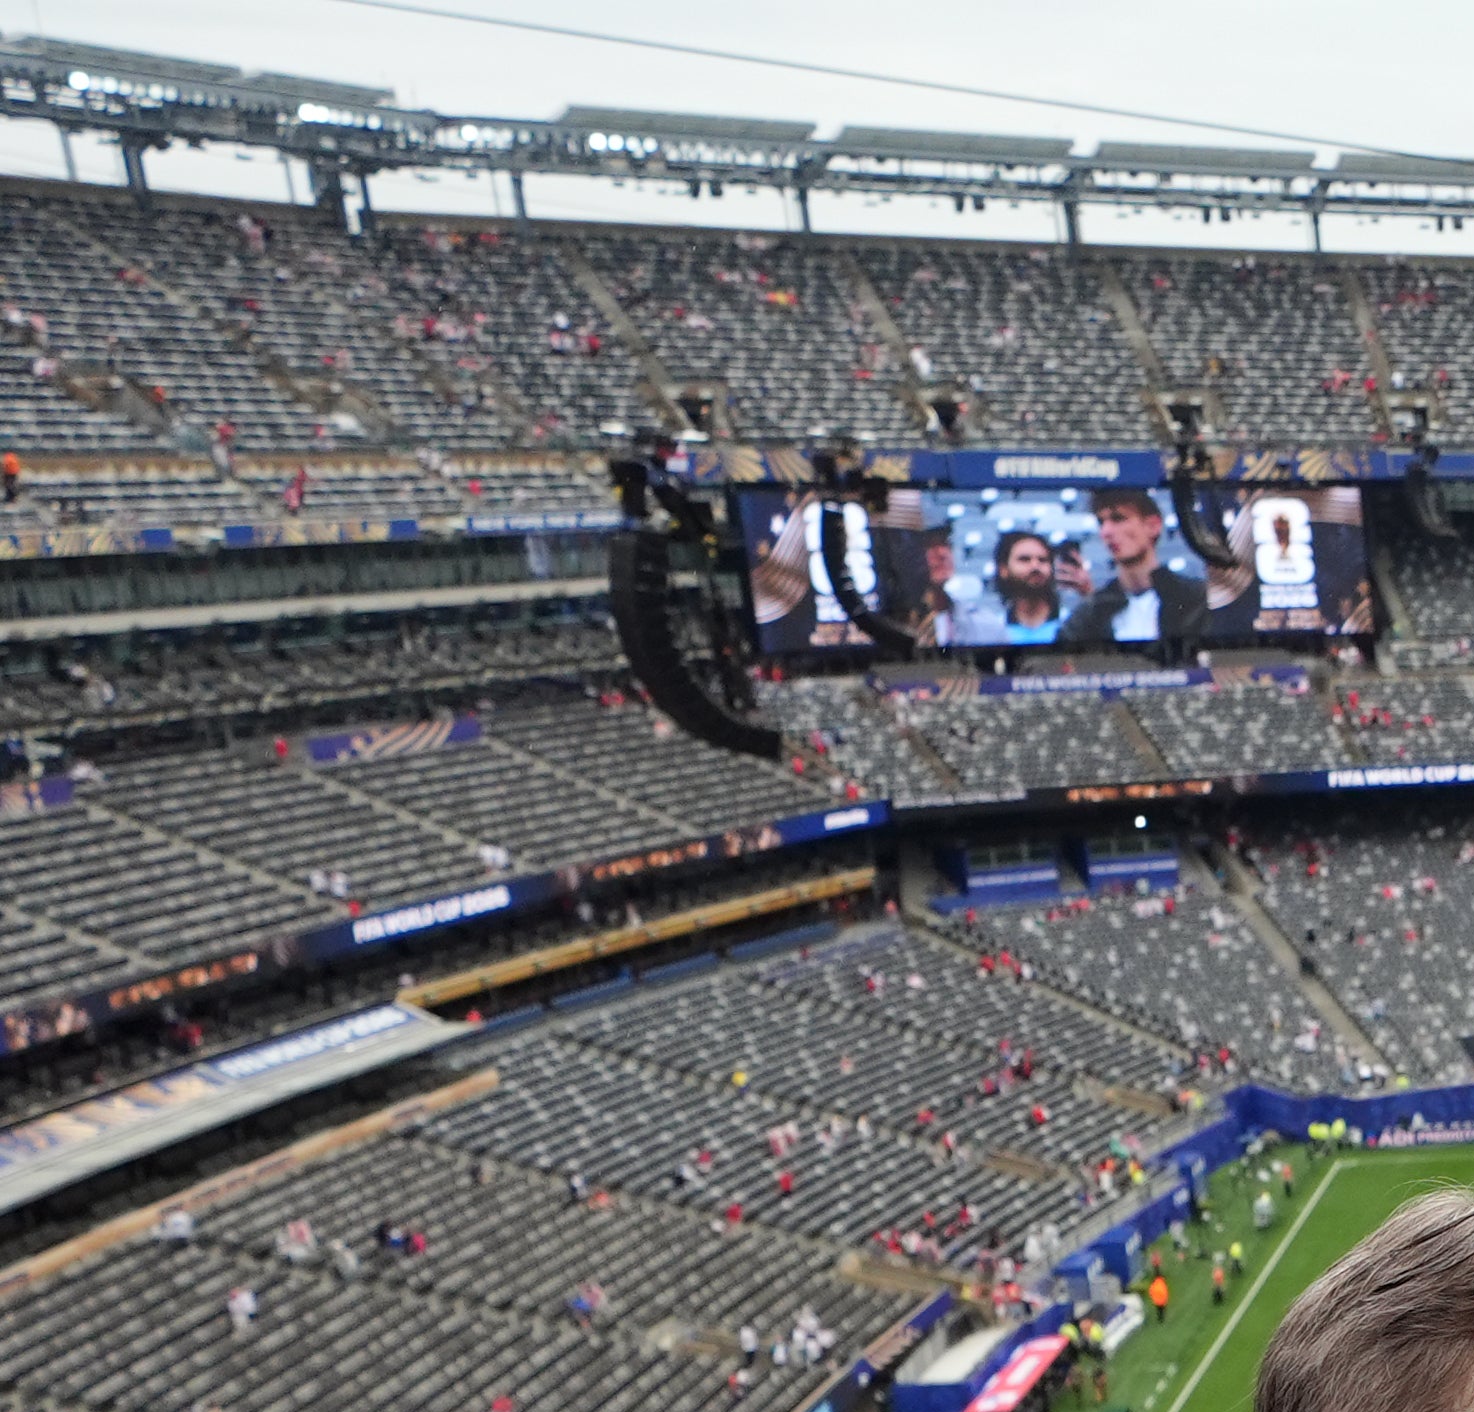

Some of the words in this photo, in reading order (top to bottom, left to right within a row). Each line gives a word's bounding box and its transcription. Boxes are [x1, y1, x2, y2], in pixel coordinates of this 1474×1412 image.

[1012, 676, 1045, 691] FIFA
[1047, 674, 1101, 691] WORLD
[1101, 672, 1133, 689] CUP
[1134, 670, 1188, 688] 2026
[1328, 770, 1364, 788] FIFA
[1365, 766, 1424, 786] WORLD
[1425, 765, 1457, 783] CUP
[353, 917, 386, 944] FIFA
[384, 902, 436, 935] WORLD
[433, 896, 461, 923] CUP
